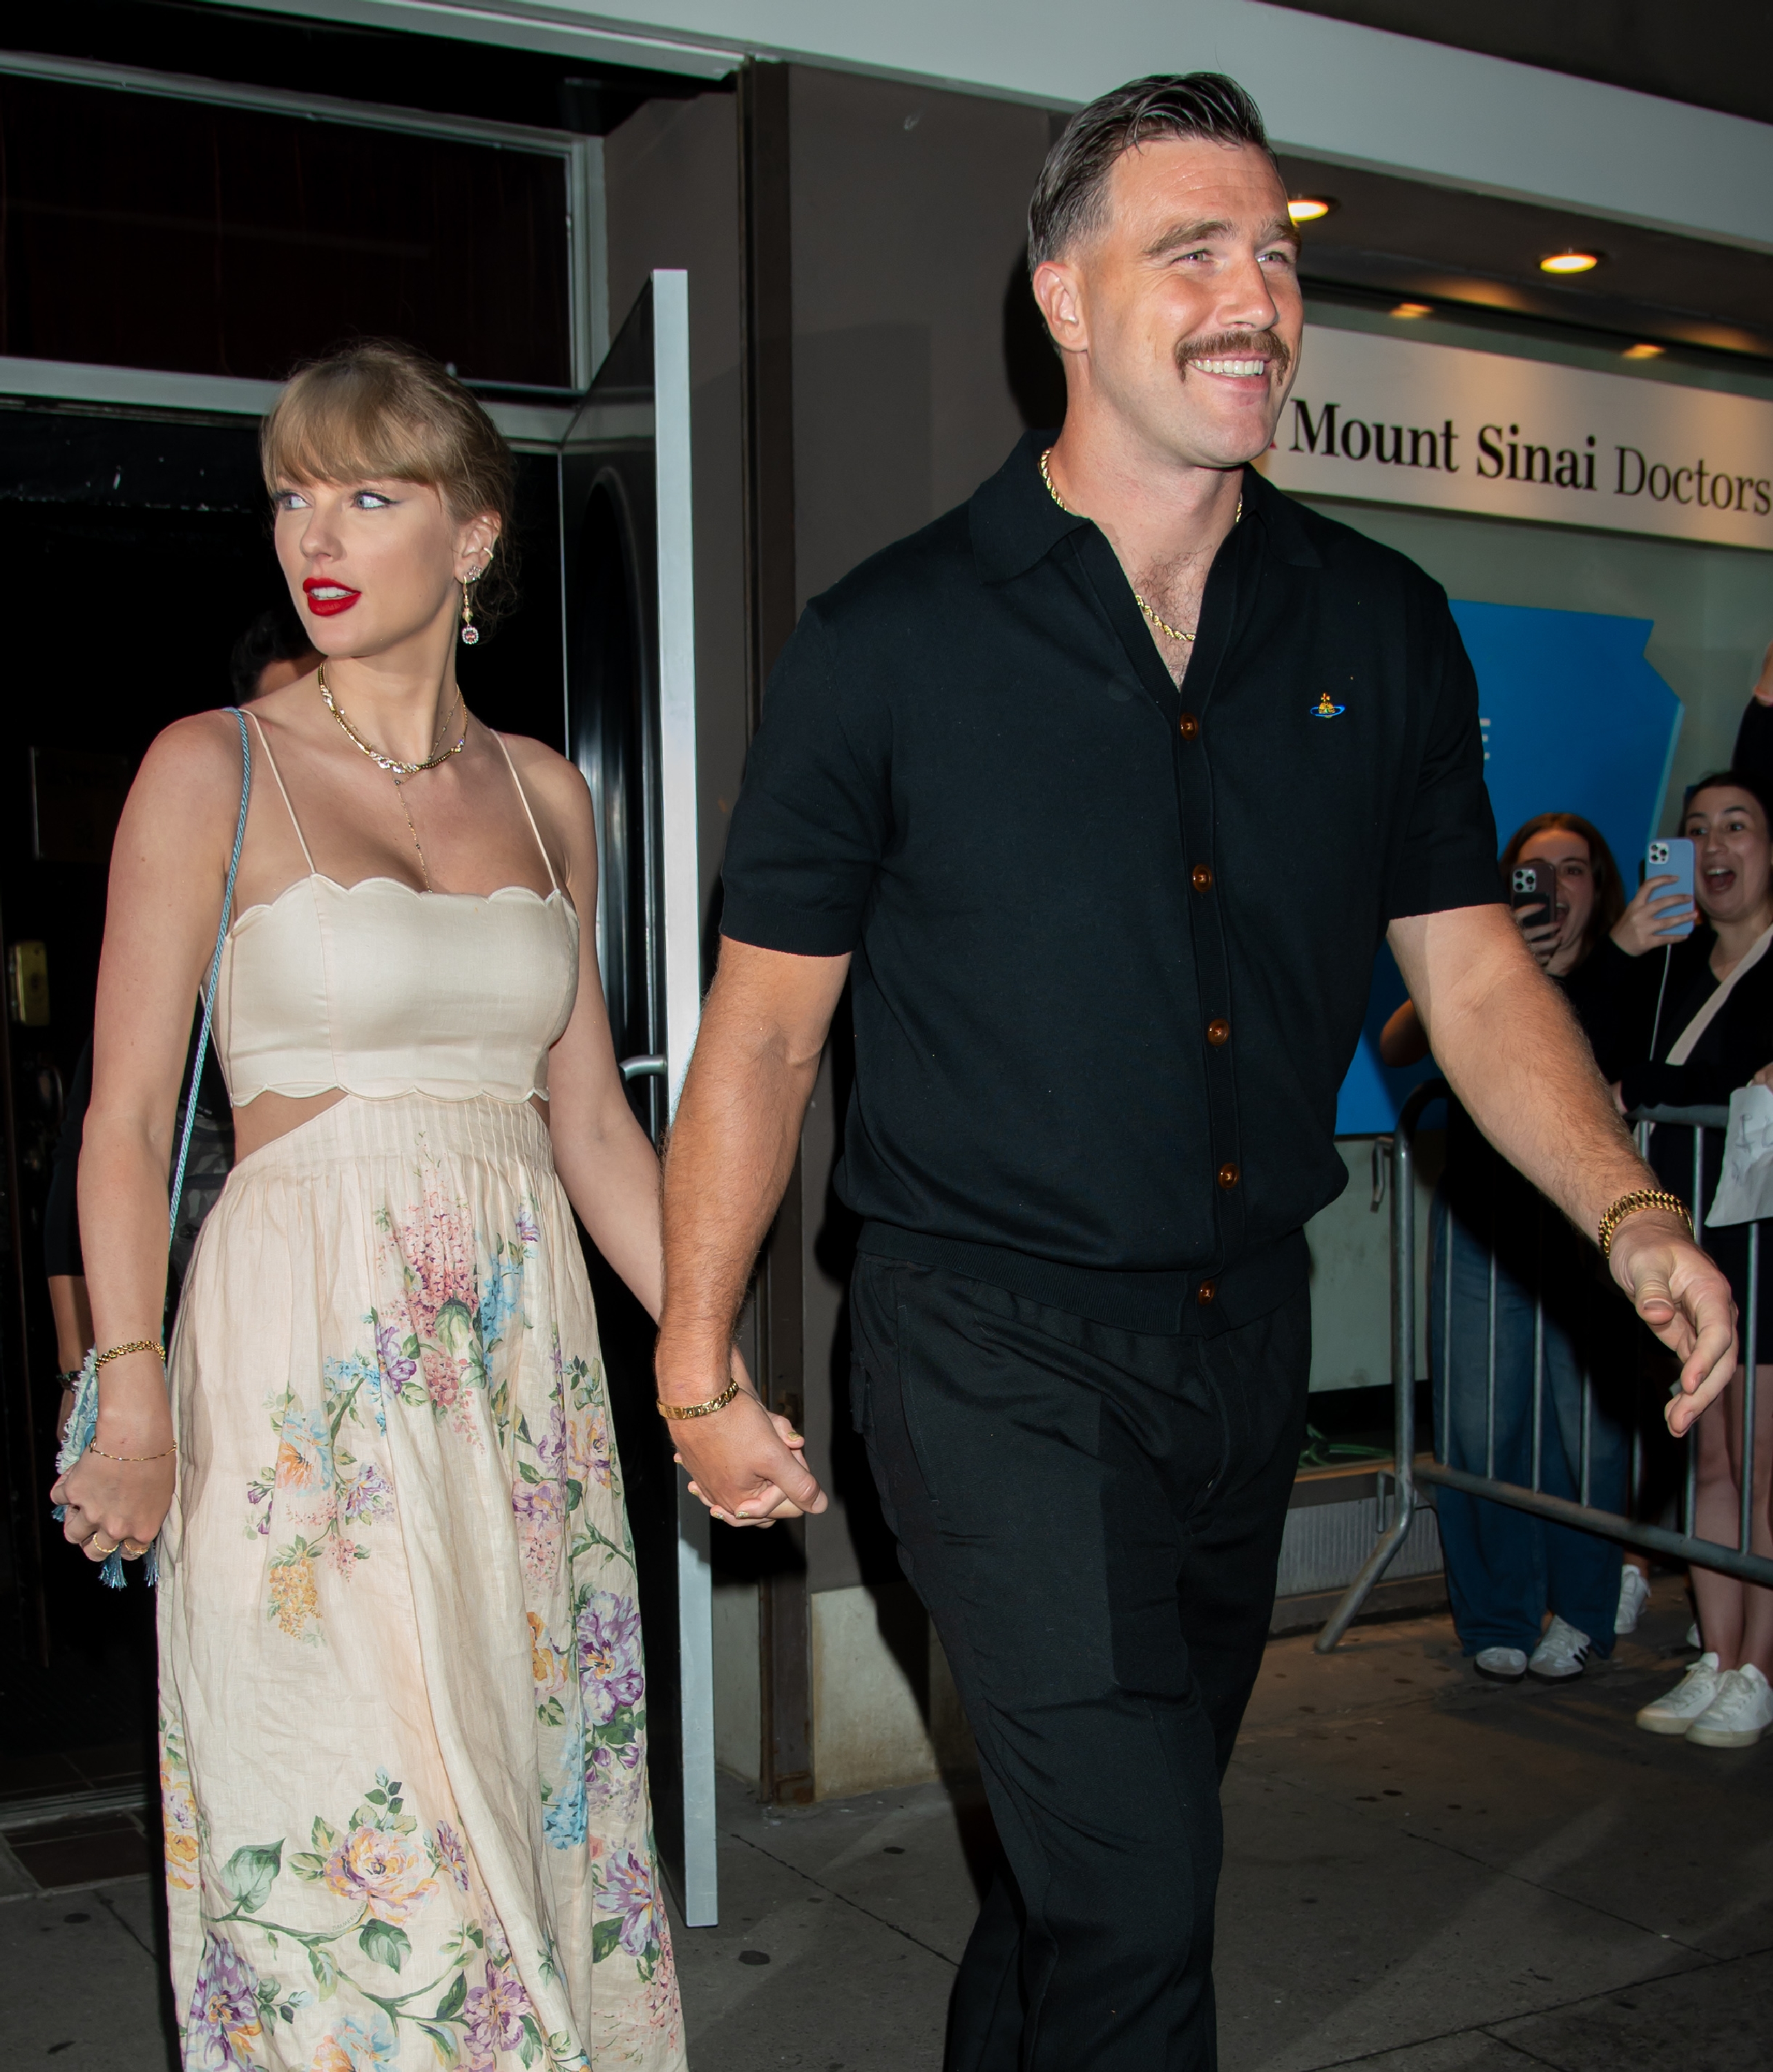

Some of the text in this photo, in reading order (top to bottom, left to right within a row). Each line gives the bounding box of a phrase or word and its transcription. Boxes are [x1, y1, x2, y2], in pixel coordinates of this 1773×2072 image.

[1289, 397, 1772, 516] Mount Sinai Doctors
